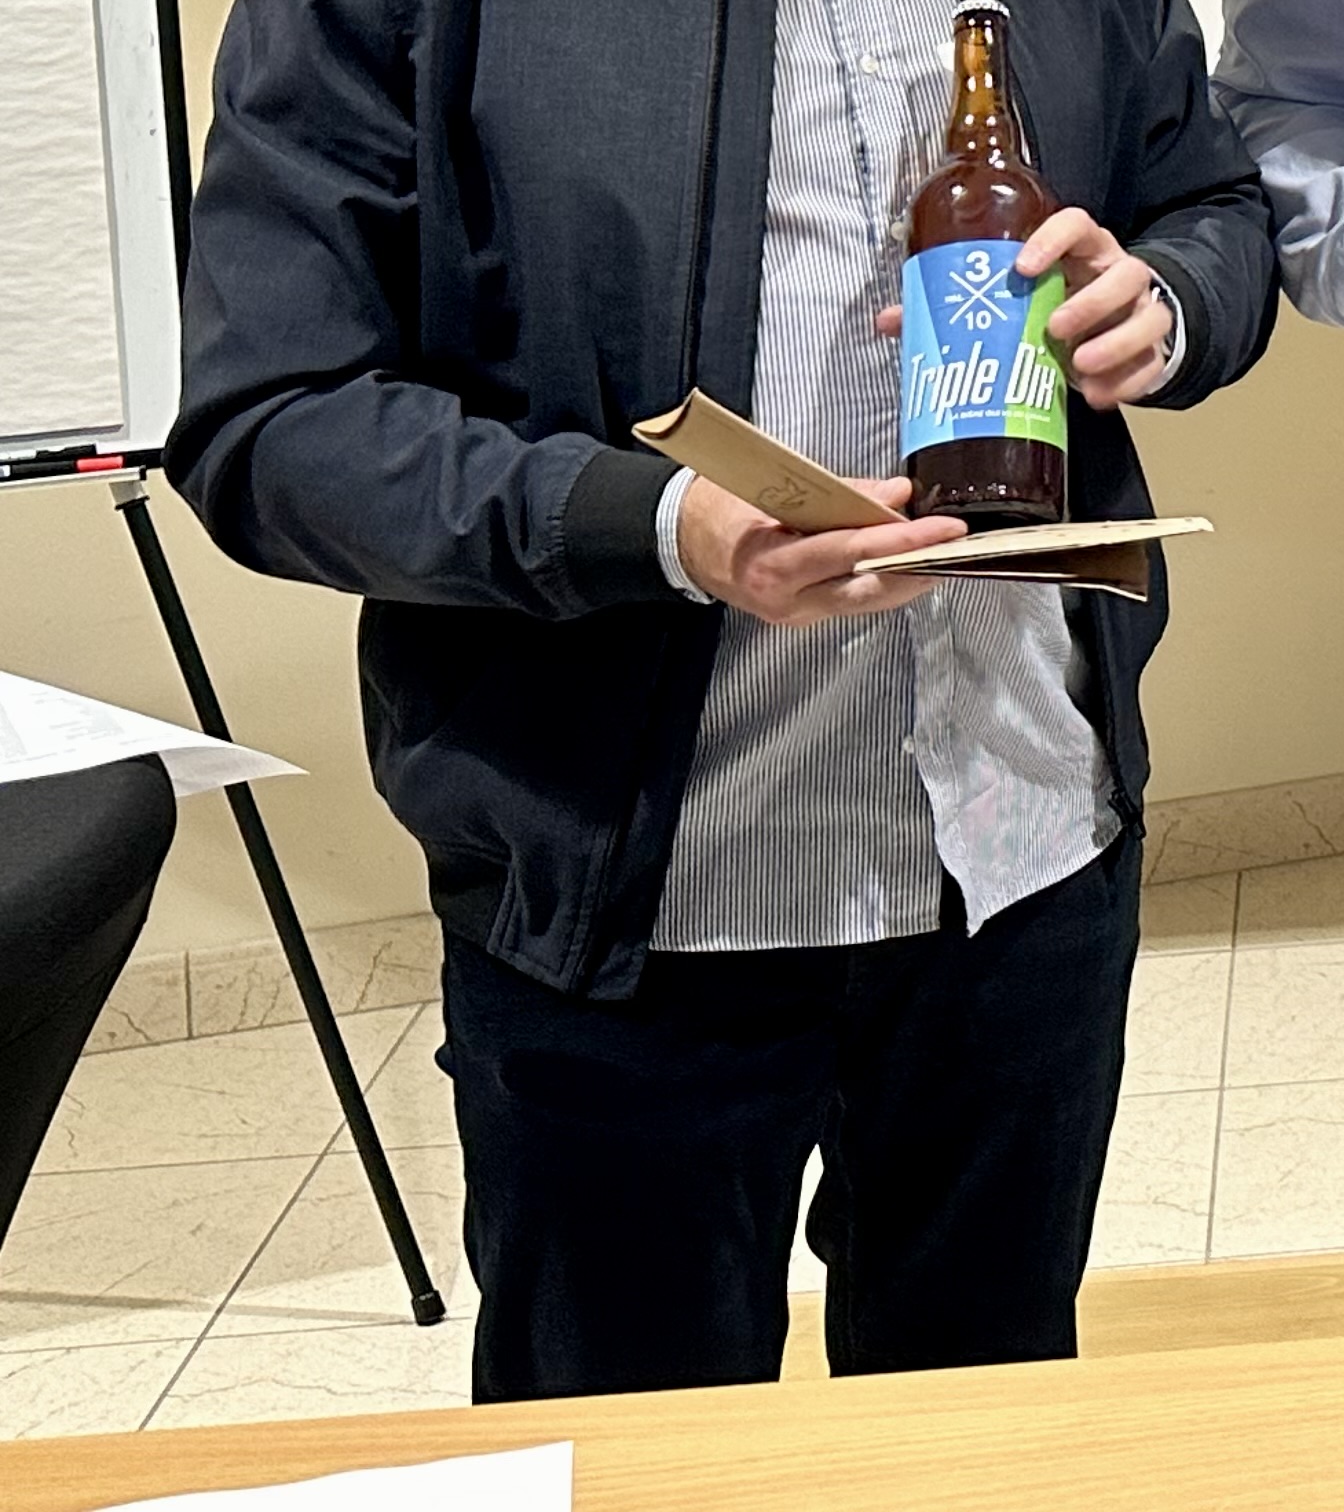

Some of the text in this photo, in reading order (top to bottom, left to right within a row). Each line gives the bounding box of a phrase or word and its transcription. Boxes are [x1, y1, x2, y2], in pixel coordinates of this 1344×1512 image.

[964, 250, 992, 283] 3
[964, 310, 992, 331] 10
[907, 341, 1000, 427] Triple
